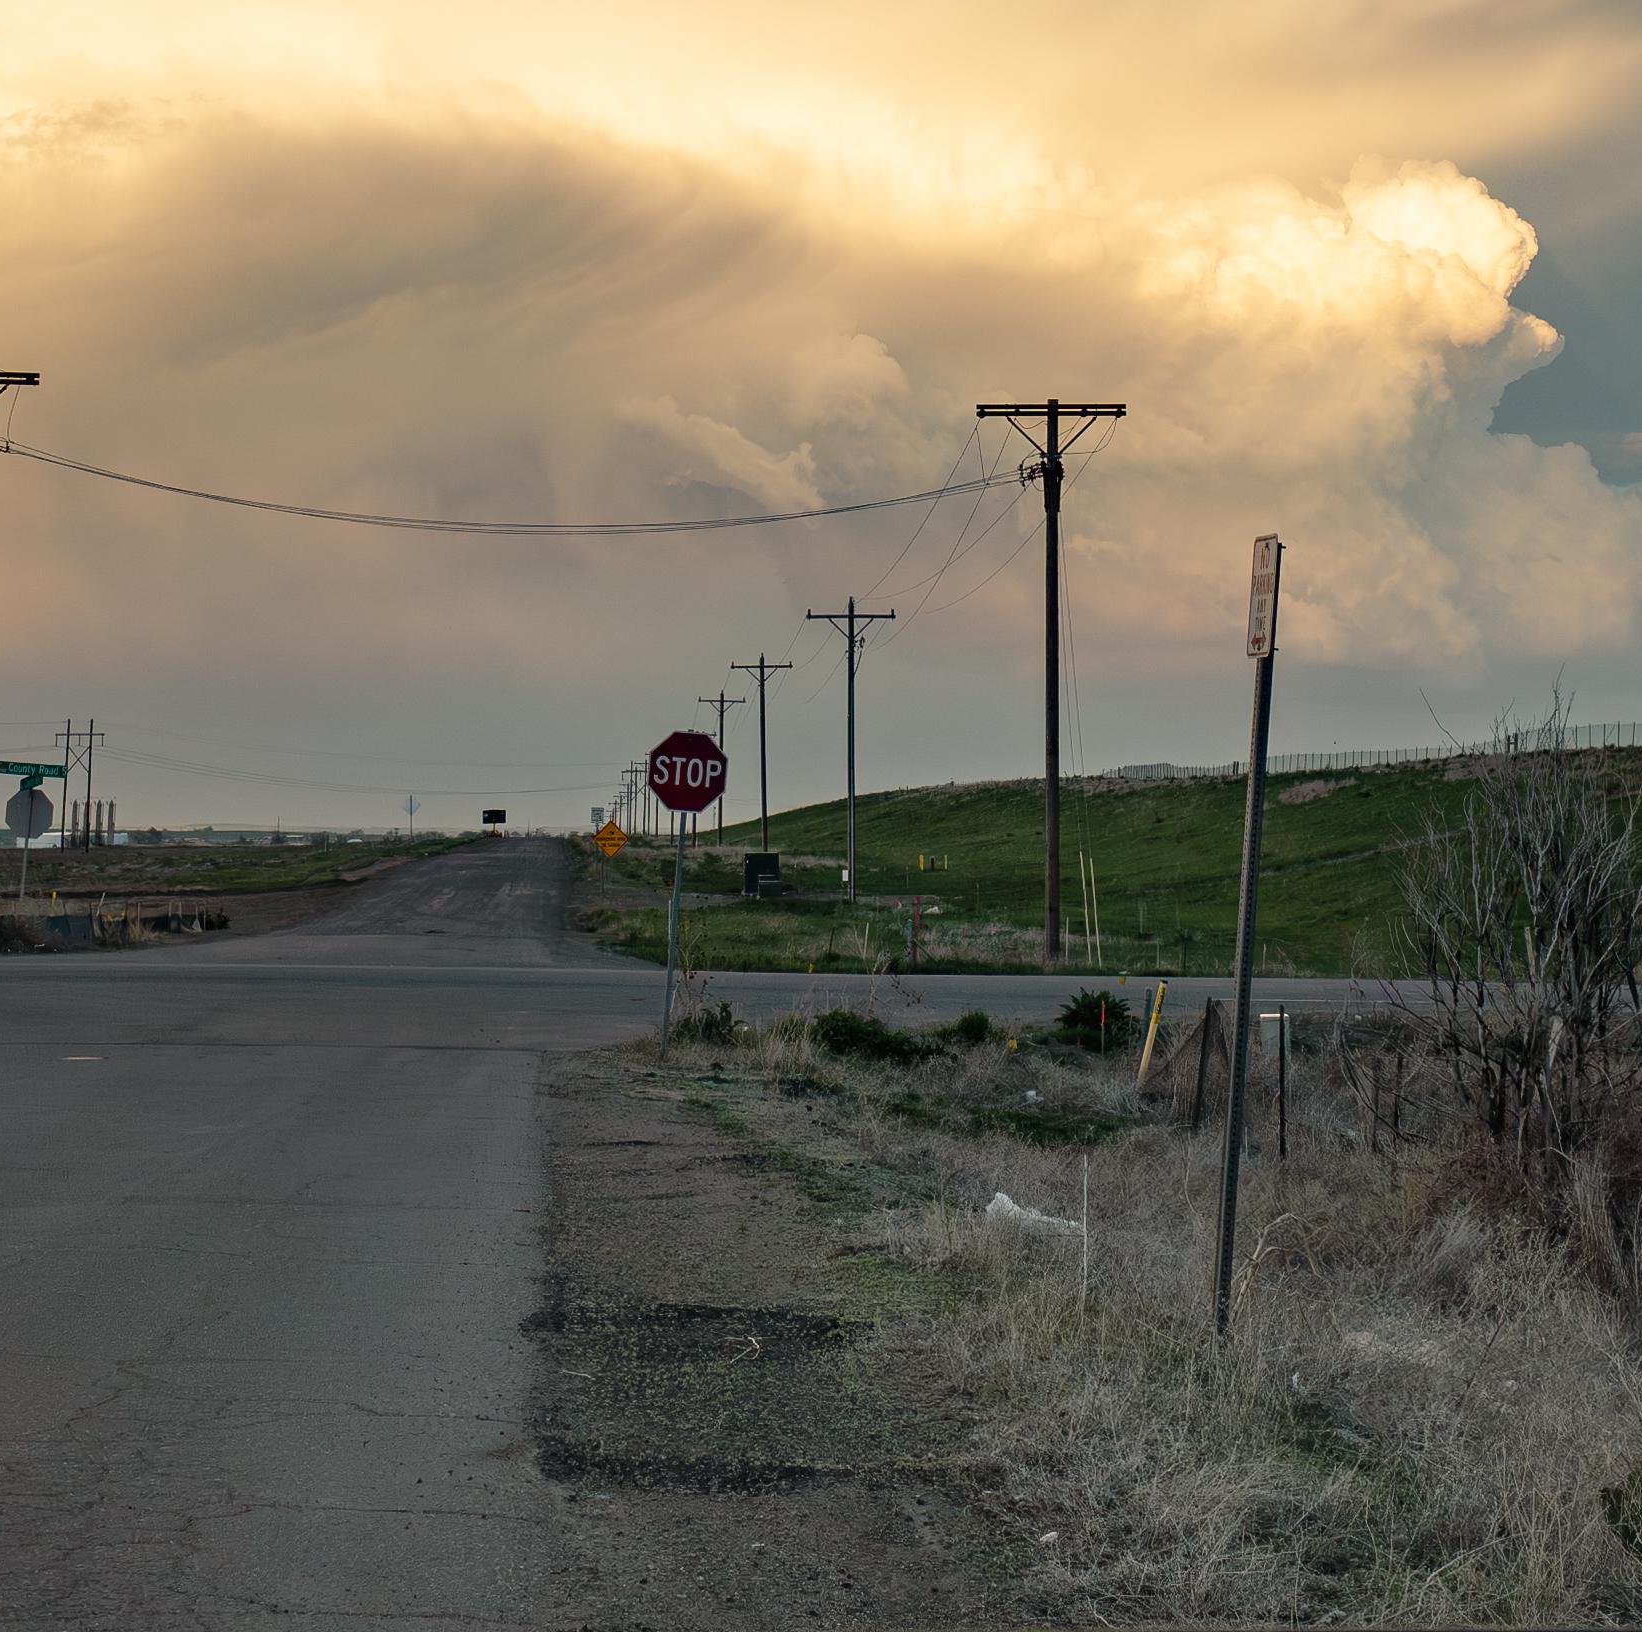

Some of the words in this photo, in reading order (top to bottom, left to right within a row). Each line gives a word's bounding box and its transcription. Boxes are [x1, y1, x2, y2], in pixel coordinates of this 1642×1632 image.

[1260, 546, 1270, 569] NO
[1252, 572, 1275, 596] PARKING
[1257, 599, 1267, 614] ANY
[1255, 616, 1266, 632] TIME
[8, 763, 36, 776] County
[39, 765, 59, 775] Road
[653, 755, 722, 788] STOP
